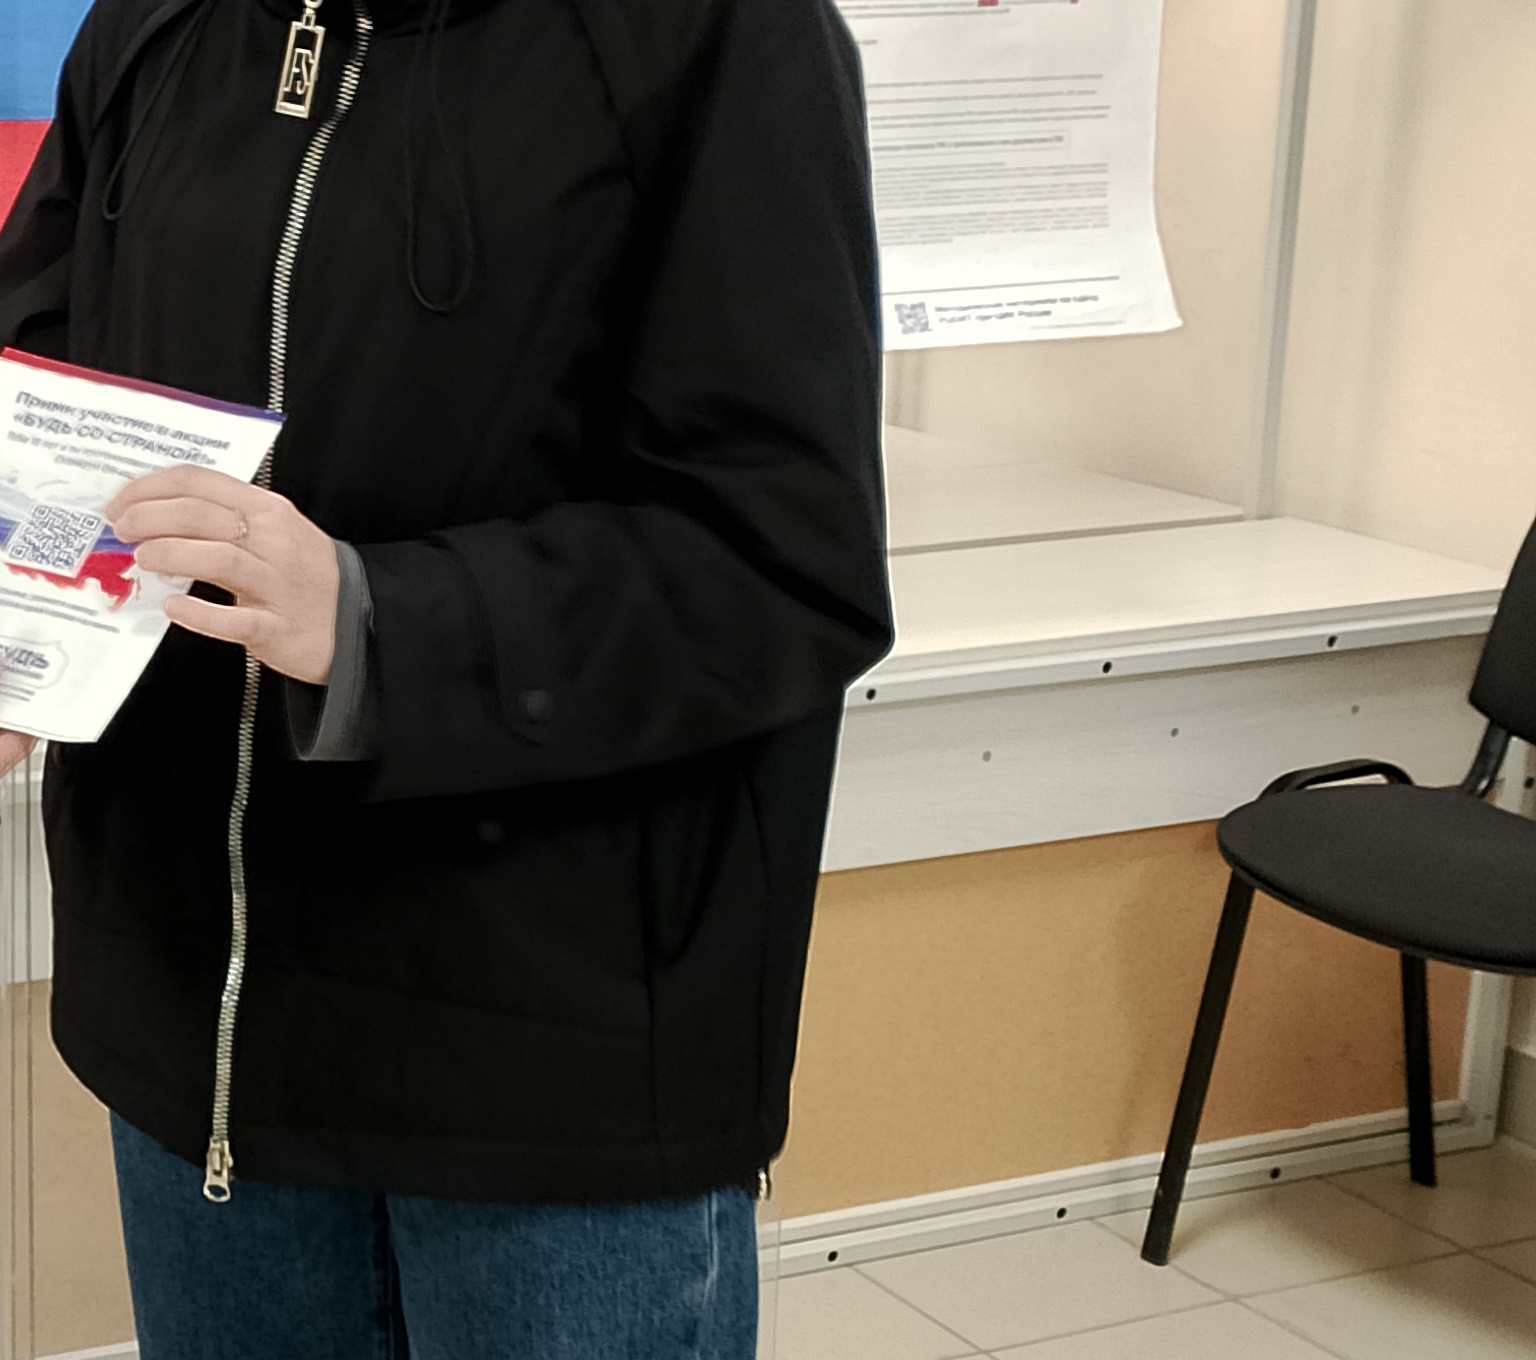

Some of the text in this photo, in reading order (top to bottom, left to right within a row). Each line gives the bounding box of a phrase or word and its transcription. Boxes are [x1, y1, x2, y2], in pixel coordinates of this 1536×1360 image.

[15, 390, 77, 415] Прими
[78, 408, 154, 433] участие
[76, 424, 104, 441] СО
